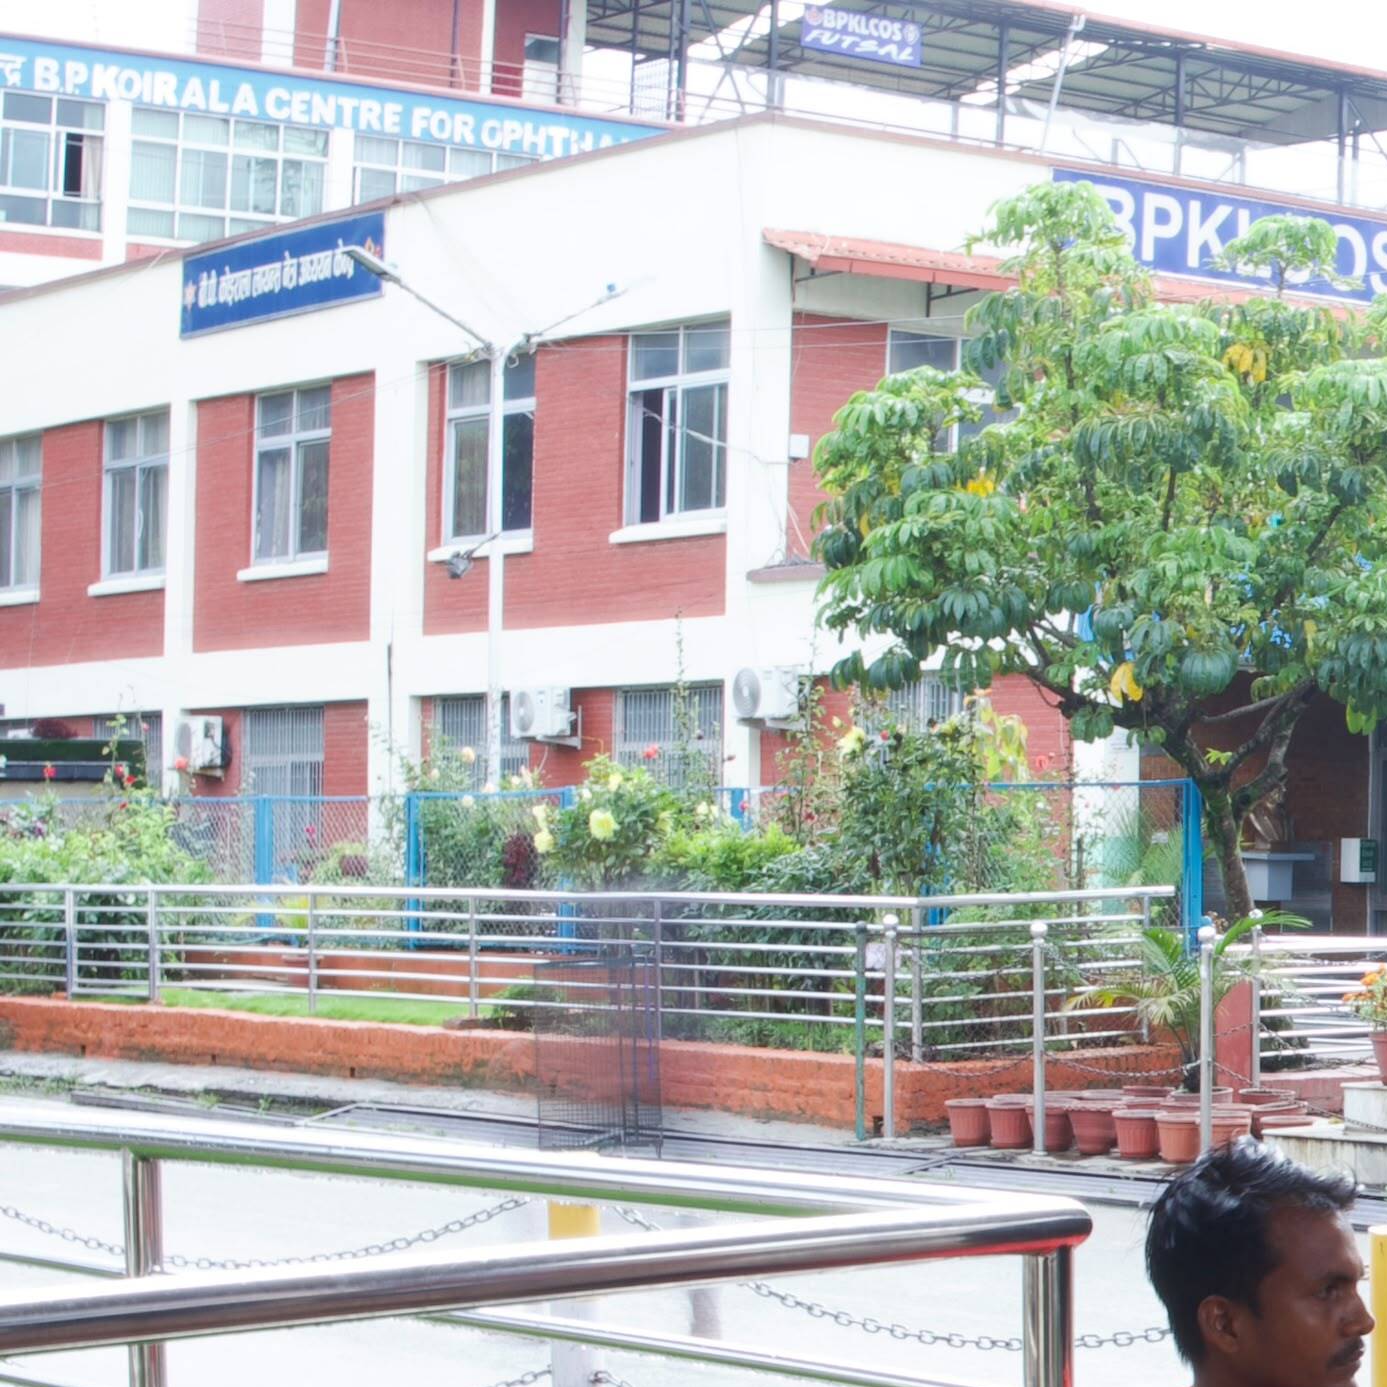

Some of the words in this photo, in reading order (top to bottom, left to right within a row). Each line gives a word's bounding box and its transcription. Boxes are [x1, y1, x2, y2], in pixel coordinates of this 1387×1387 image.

[823, 8, 902, 41] BPKLCOS
[804, 29, 914, 60] FUTSAL
[91, 62, 259, 117] KOIRALA
[265, 86, 402, 134] CENTRE
[411, 106, 475, 145] FOR
